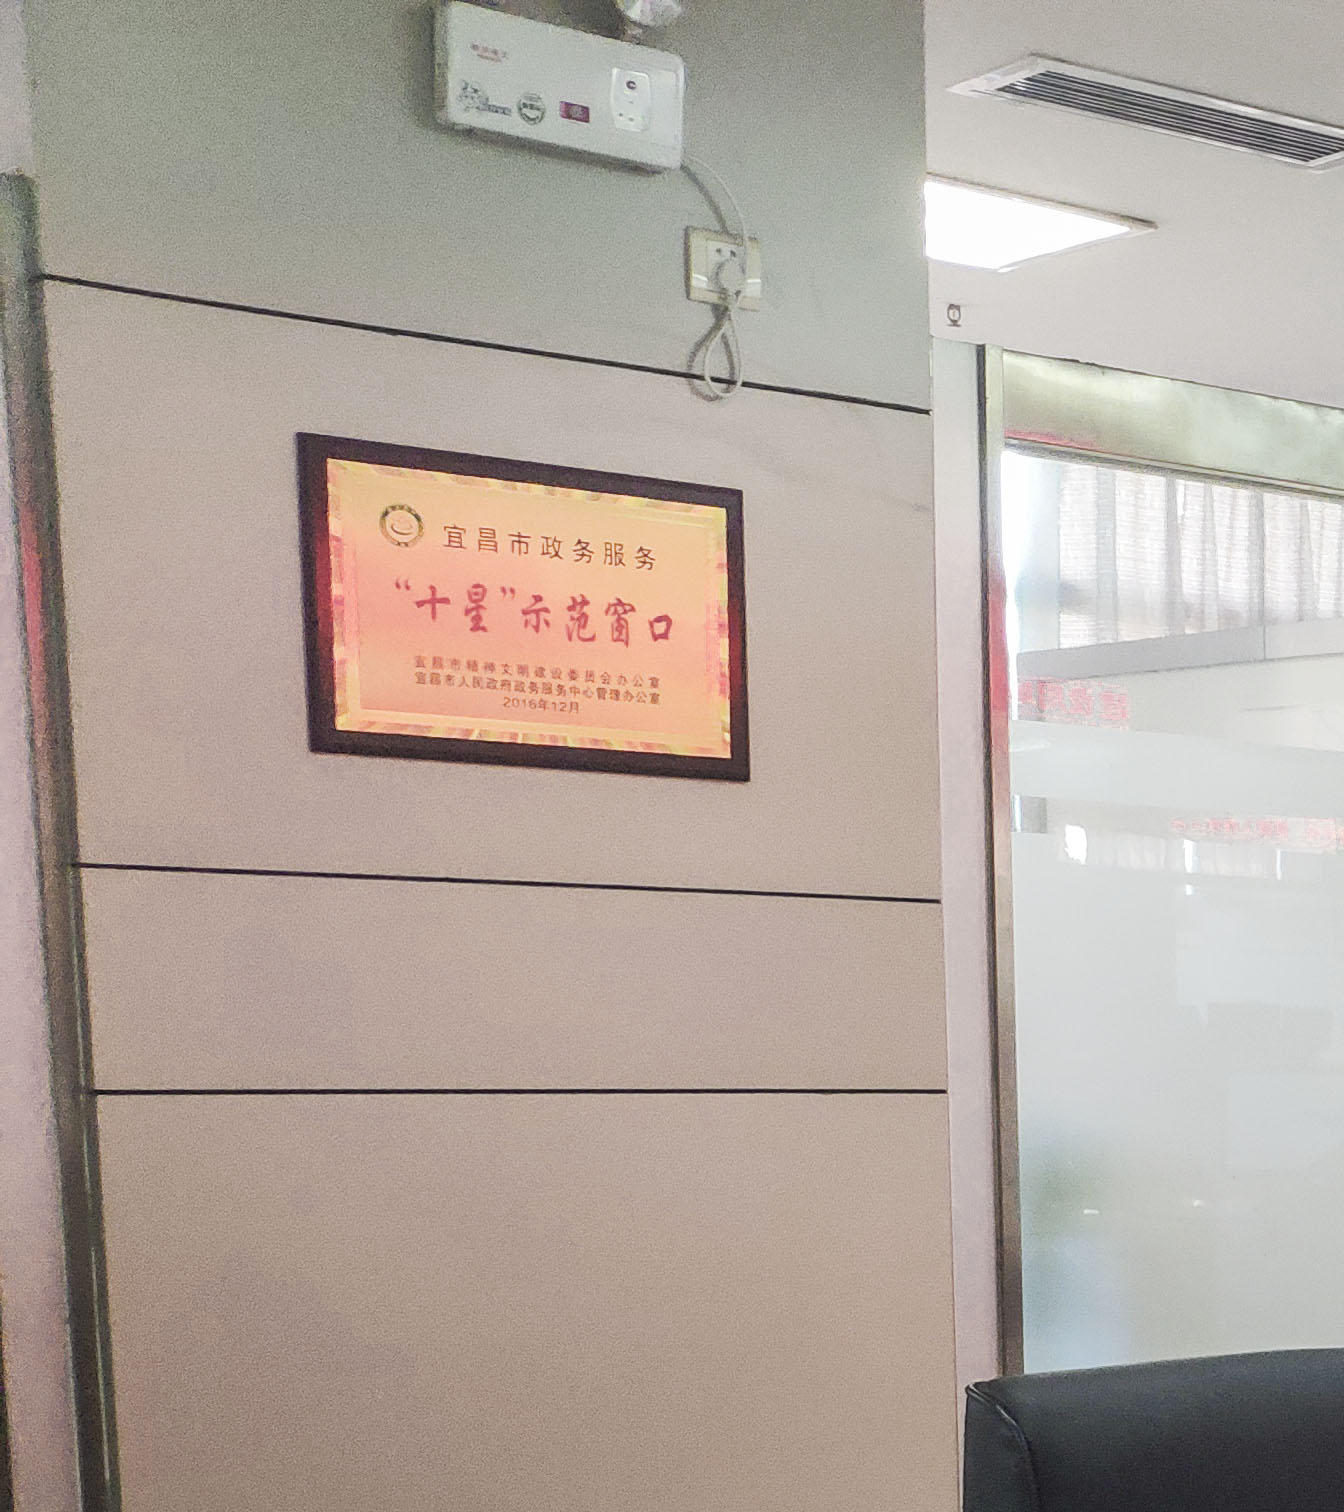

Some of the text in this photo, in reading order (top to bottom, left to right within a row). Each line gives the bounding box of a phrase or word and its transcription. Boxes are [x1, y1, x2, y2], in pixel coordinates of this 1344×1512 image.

[443, 524, 657, 572] 宜昌市政务服务
[503, 696, 580, 714] 2016年12月
